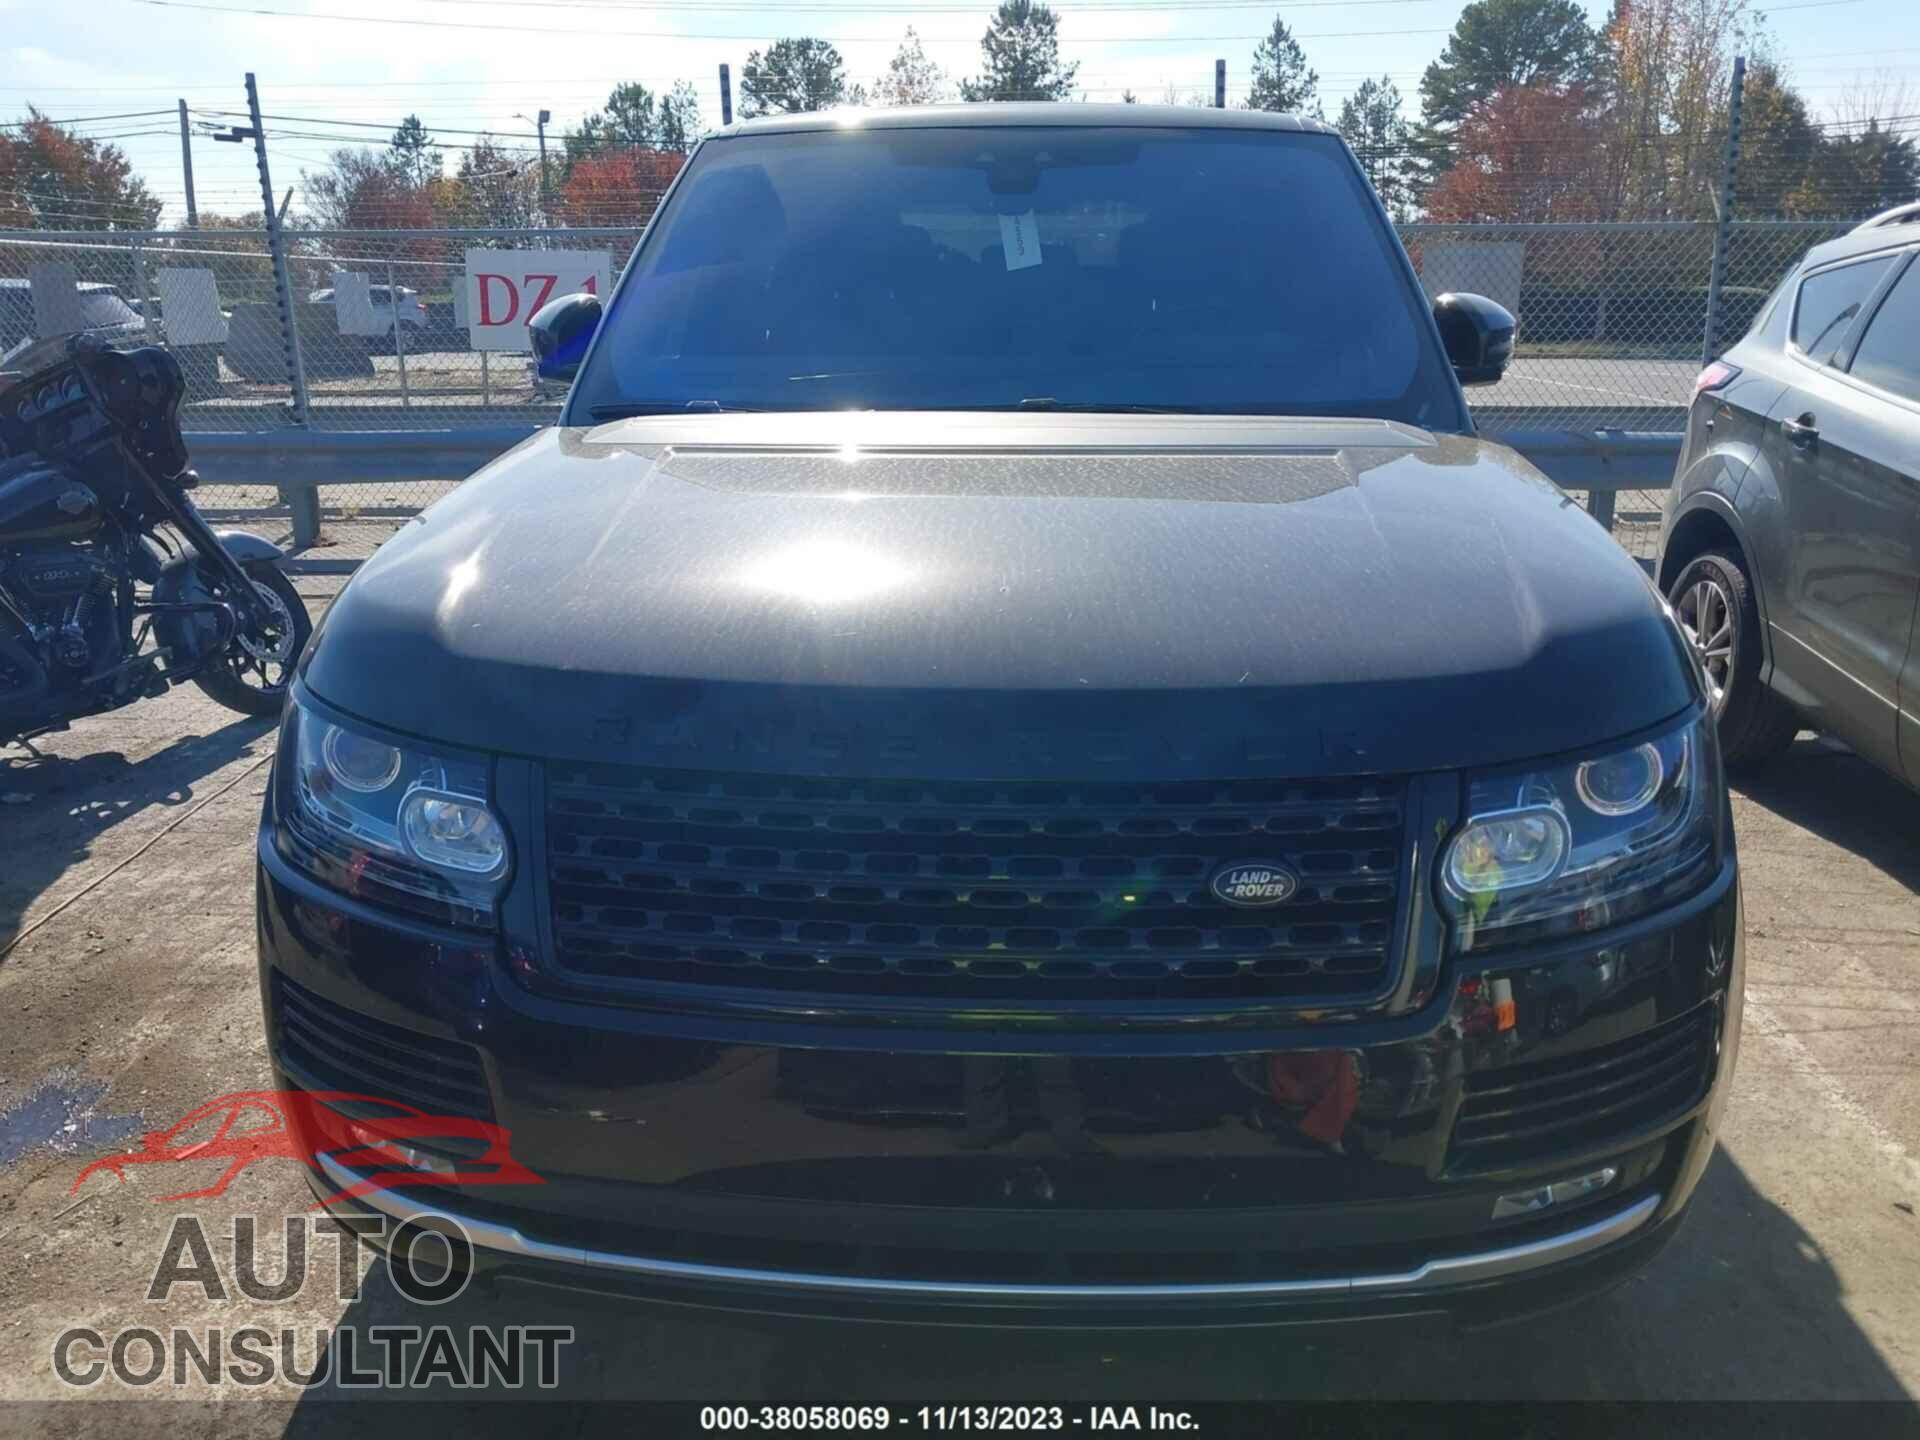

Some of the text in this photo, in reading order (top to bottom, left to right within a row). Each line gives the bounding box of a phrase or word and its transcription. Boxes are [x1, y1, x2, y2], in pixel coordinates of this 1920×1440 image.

[474, 274, 558, 327] DZ
[1229, 871, 1271, 884] LAND
[1234, 883, 1285, 897] ROVER
